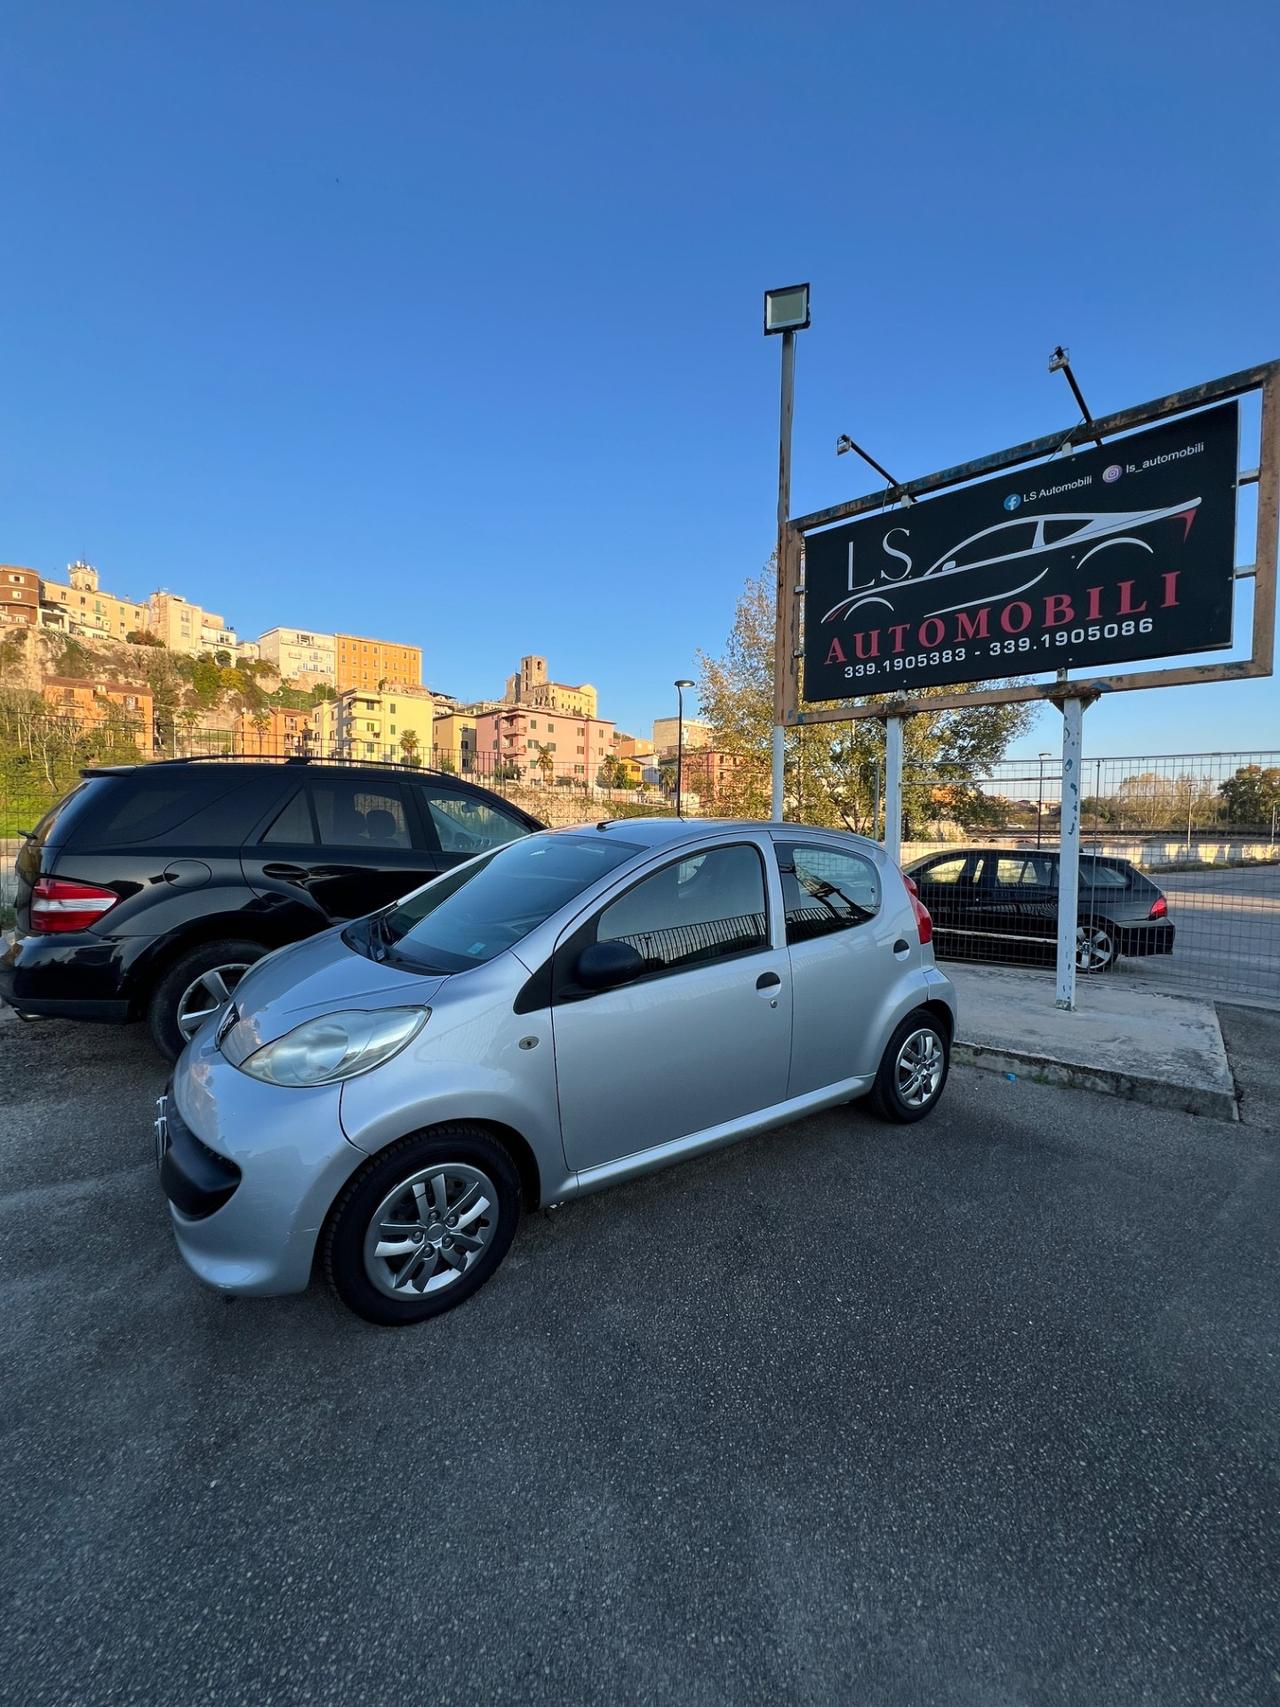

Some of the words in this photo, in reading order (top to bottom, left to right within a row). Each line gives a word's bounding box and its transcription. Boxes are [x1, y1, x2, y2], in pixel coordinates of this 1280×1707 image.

[1023, 491, 1037, 503] LS
[1038, 475, 1093, 498] Automobili
[1126, 442, 1205, 474] ls_automobili
[847, 527, 913, 592] LS
[824, 571, 1181, 665] AUTOMOBILI
[844, 647, 966, 680] 339.1905383
[989, 616, 1154, 656] 339.1905086
